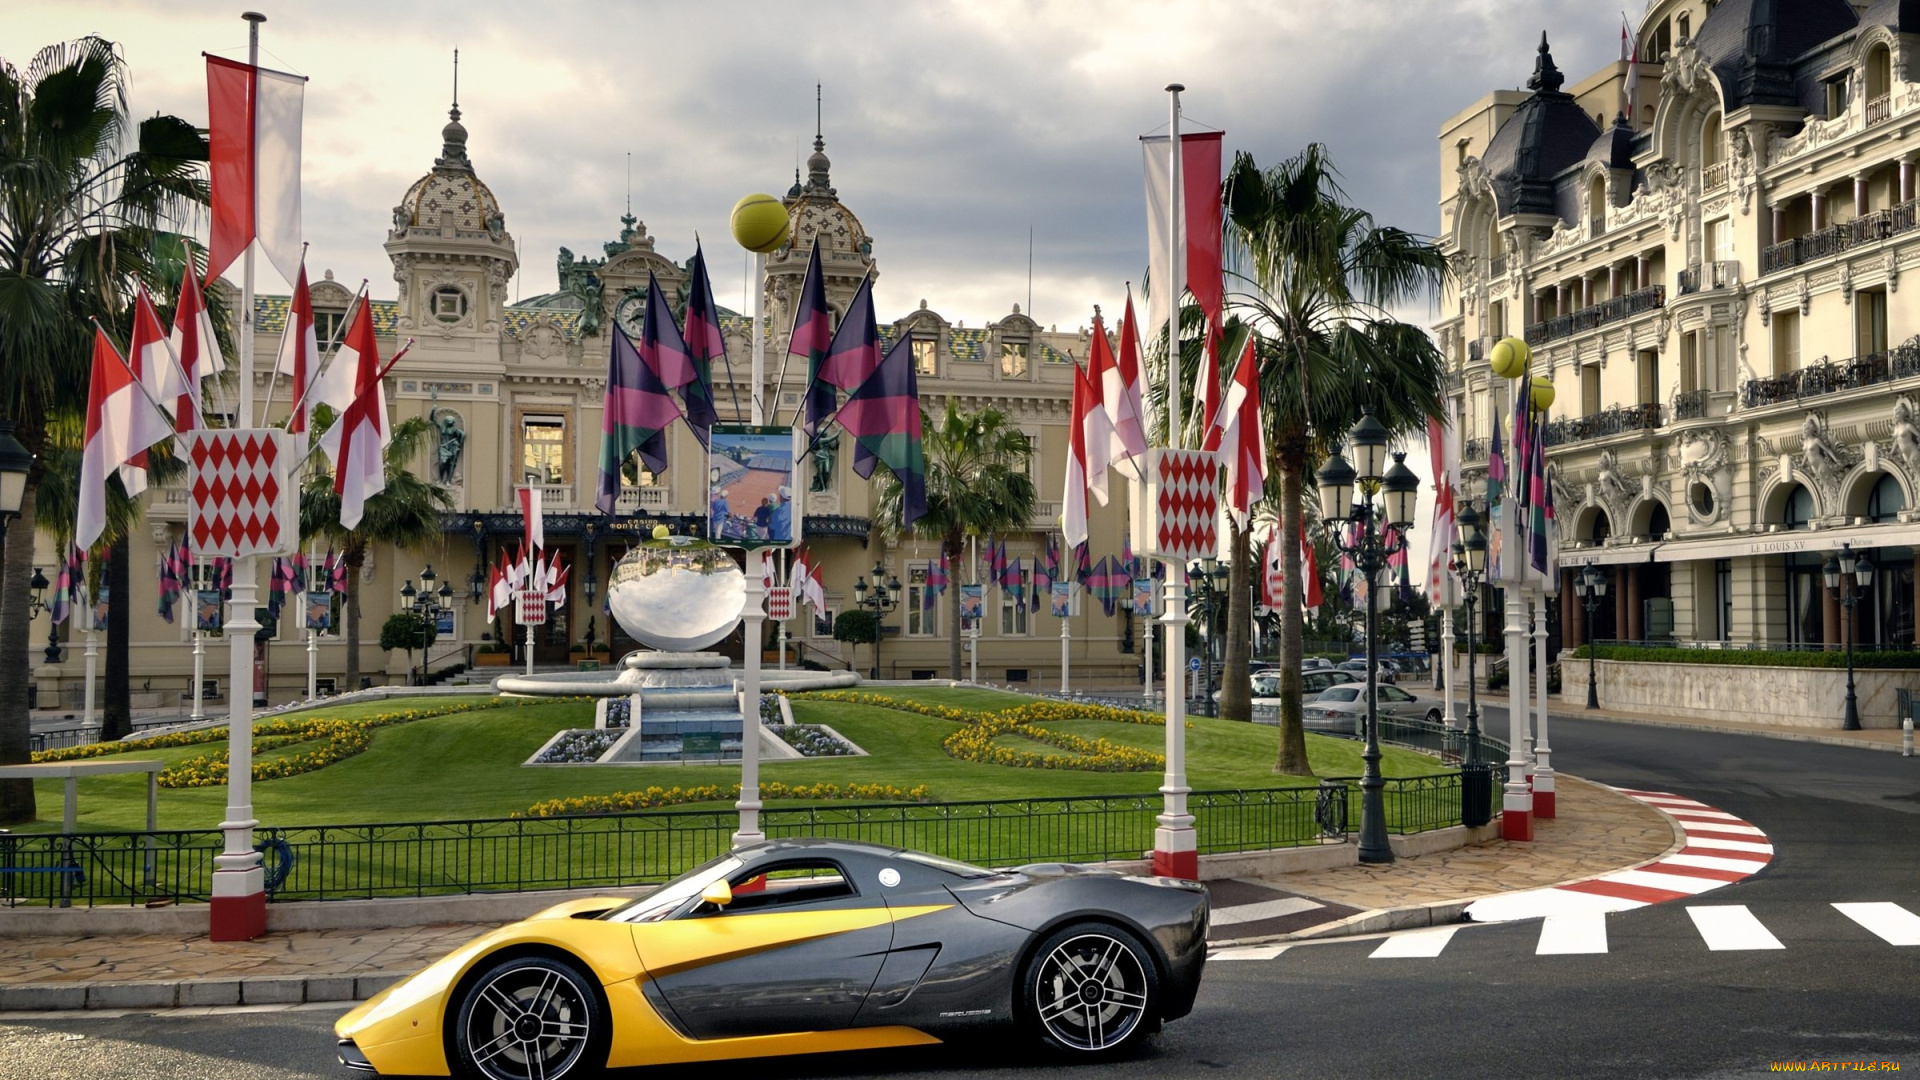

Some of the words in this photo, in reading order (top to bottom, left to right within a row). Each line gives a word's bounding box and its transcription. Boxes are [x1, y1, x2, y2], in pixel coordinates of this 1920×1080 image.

[1751, 544, 1761, 553] LE
[1764, 541, 1790, 552] LOUIS
[1793, 540, 1805, 550] XV
